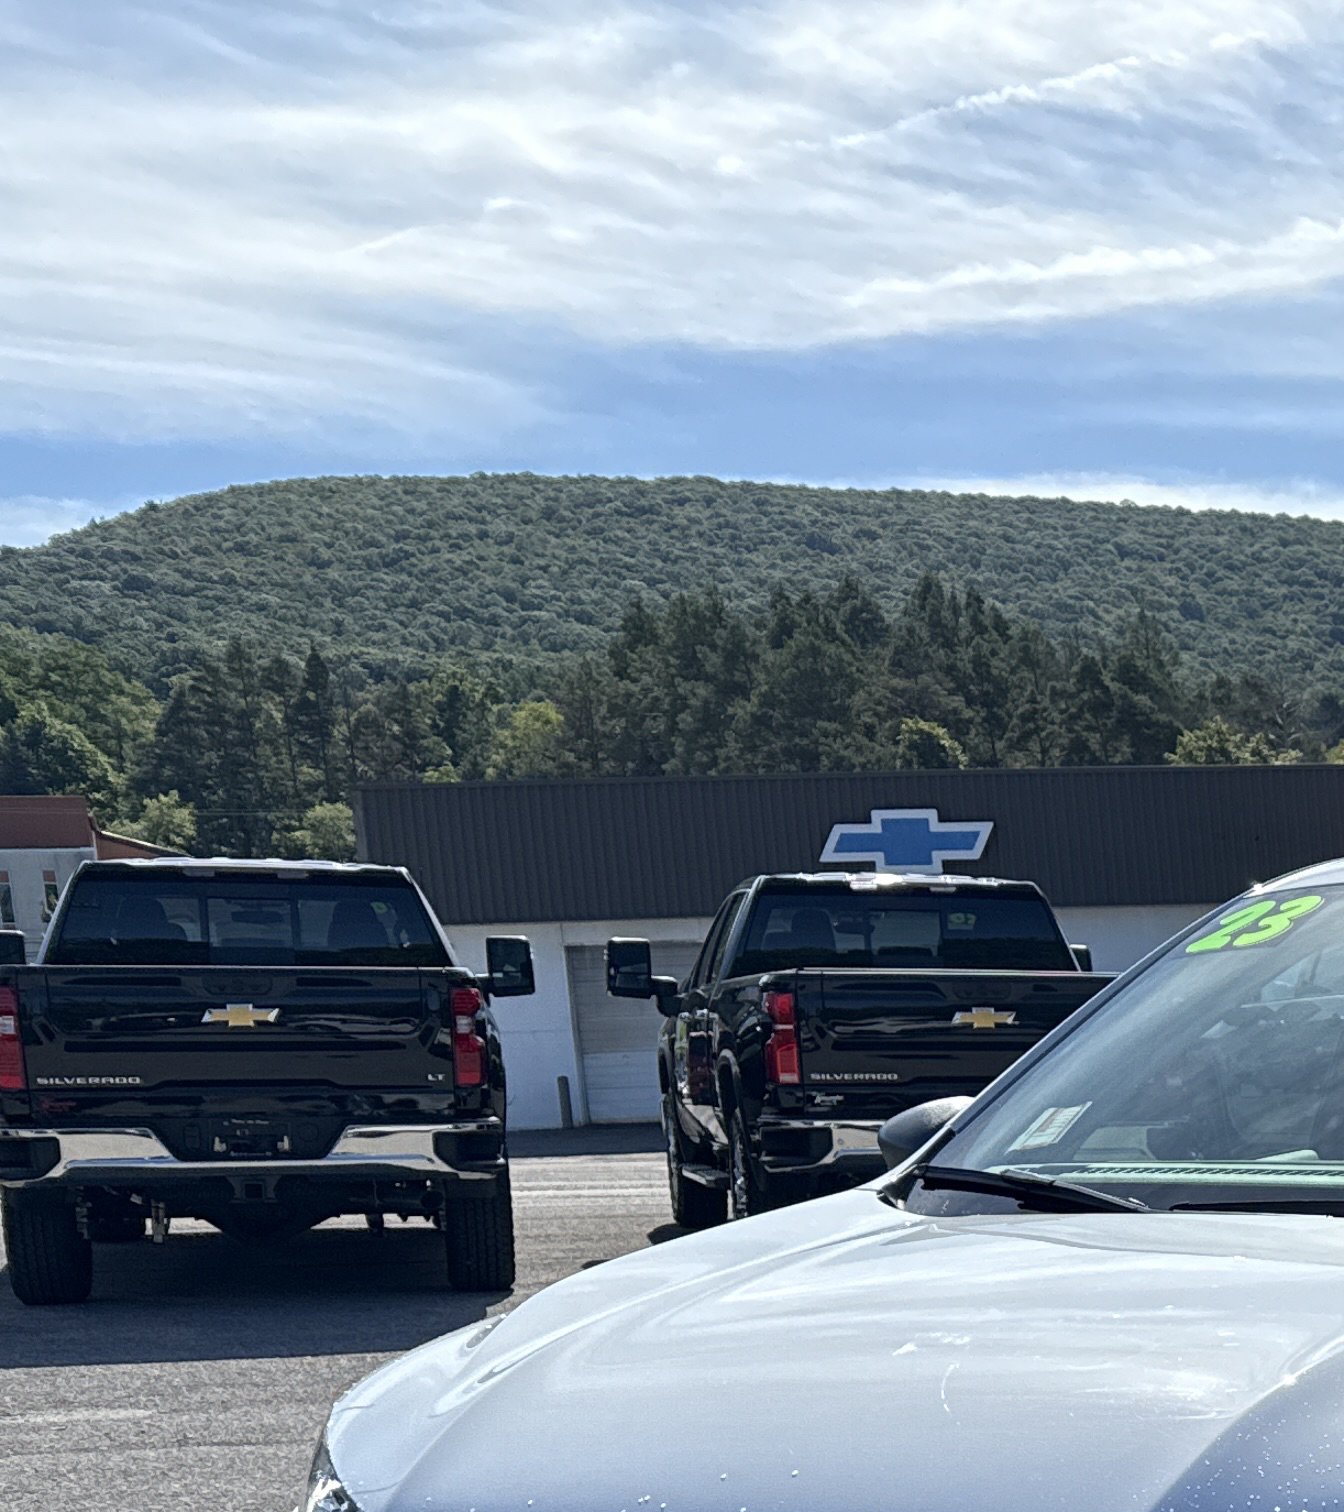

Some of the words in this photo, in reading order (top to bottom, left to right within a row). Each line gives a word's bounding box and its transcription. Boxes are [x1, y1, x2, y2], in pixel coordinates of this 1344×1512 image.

[1185, 895, 1325, 954] 23
[37, 1076, 141, 1085] SILVERADO
[810, 1072, 898, 1081] SILVERADO
